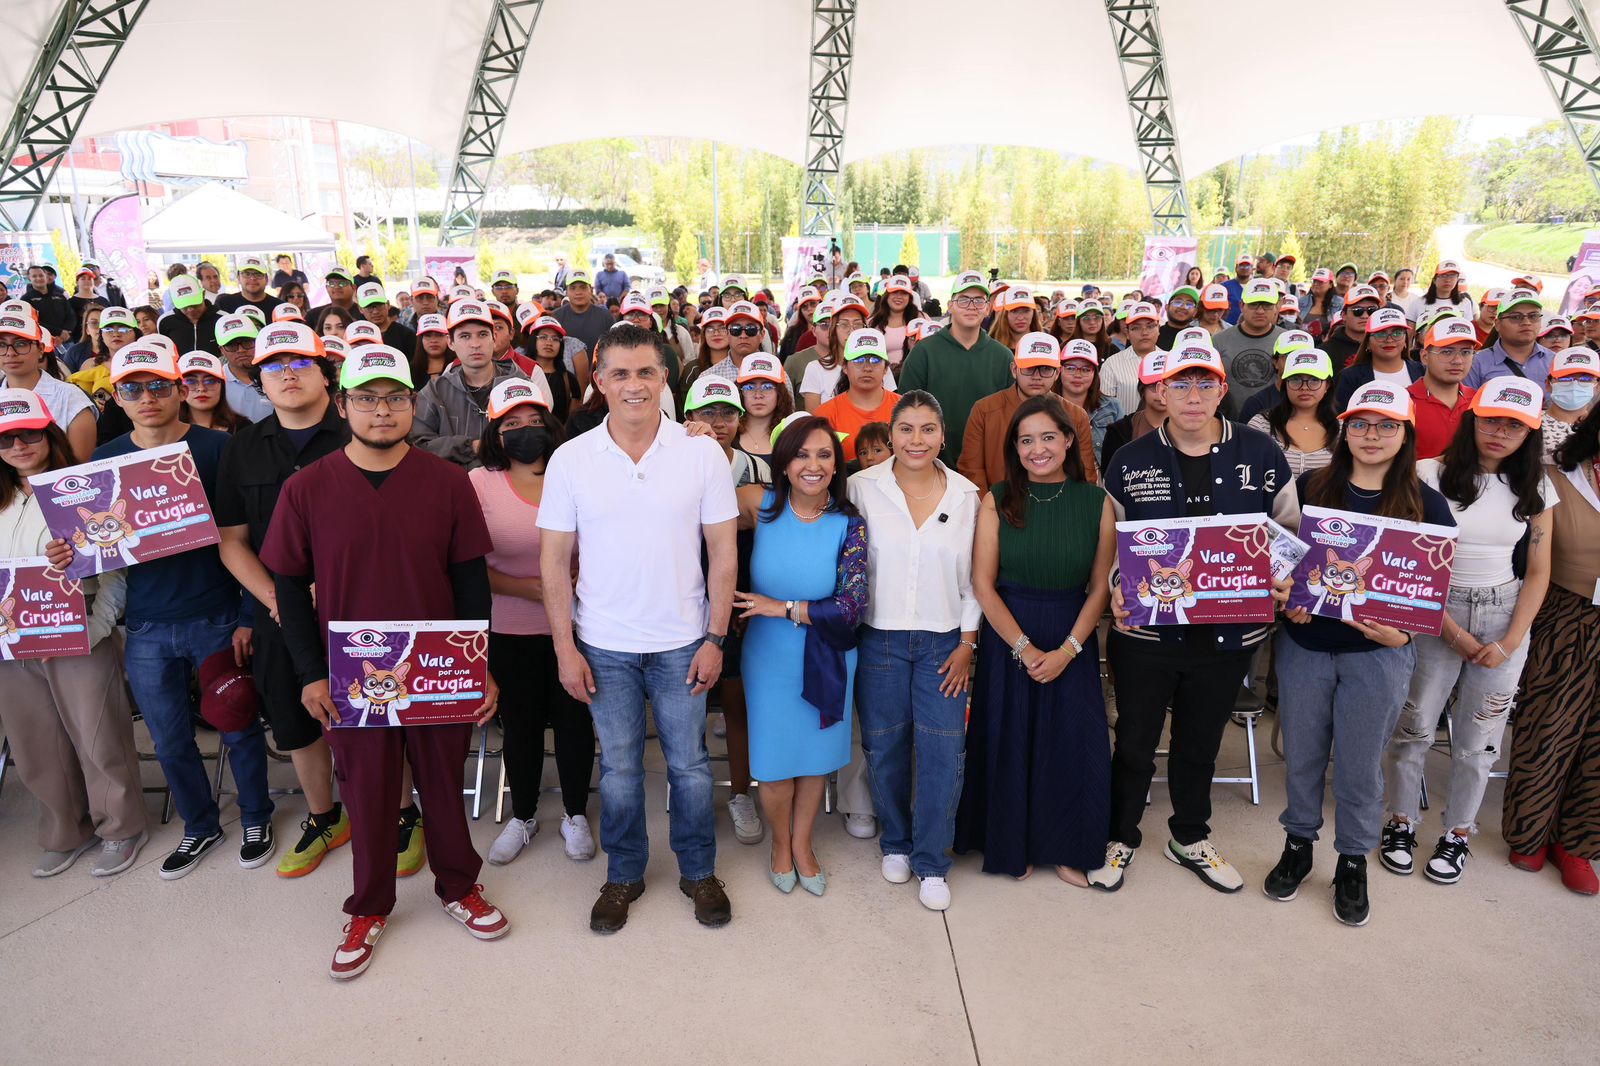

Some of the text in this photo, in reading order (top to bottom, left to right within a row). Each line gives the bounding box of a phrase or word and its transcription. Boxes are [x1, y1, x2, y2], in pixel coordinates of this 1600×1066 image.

[71, 495, 95, 506] FUTURO
[130, 484, 168, 501] Vale
[156, 493, 188, 507] por una
[135, 503, 196, 526] Cirugía
[1200, 550, 1236, 564] Vale
[1382, 551, 1417, 571] Vale
[1197, 572, 1257, 592] Cirugía
[1371, 574, 1433, 599] Cirugía
[1415, 574, 1432, 582] una
[20, 588, 53, 602] Vale
[20, 610, 74, 627] Cirugía
[418, 653, 454, 668] Vale
[413, 676, 473, 694] Cirugía
